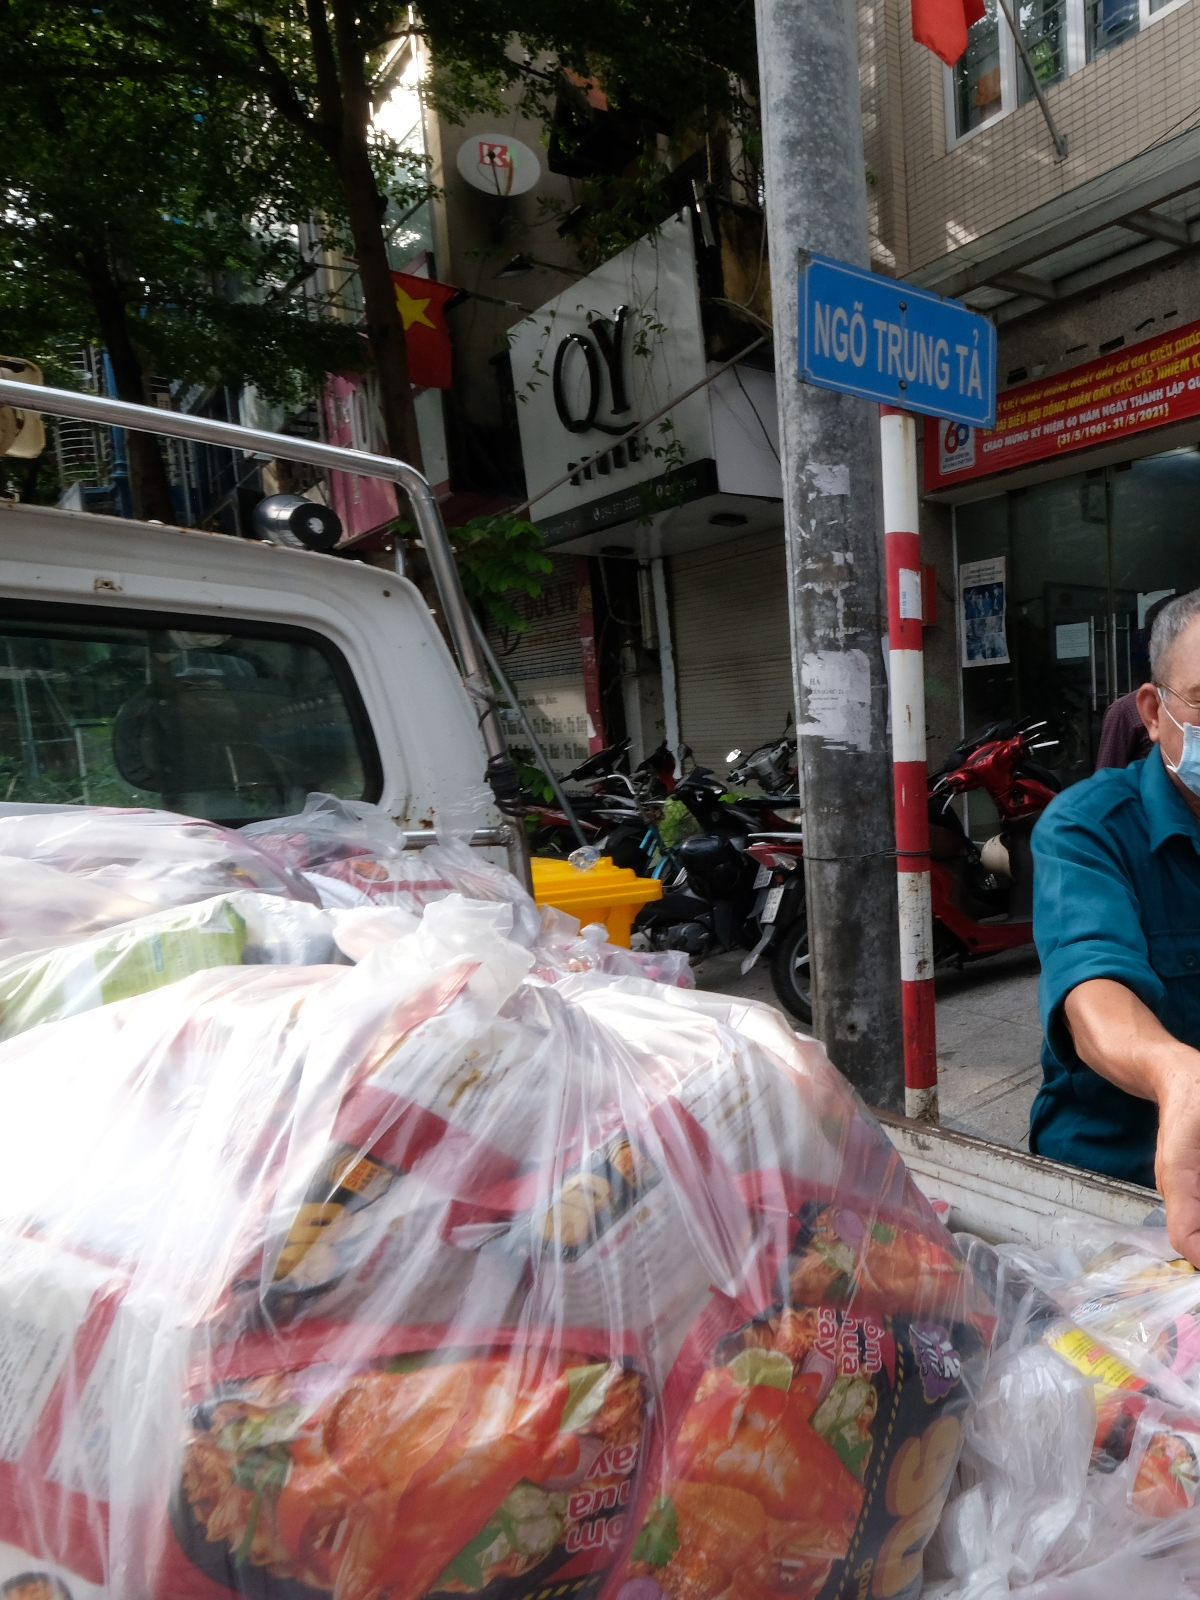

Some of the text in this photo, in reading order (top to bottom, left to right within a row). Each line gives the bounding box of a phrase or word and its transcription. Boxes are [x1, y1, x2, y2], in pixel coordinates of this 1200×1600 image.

[814, 300, 983, 400] NGÕ TRUNG TẢ
[1066, 415, 1078, 428] 60
[1102, 399, 1128, 418] NGÀY
[1129, 387, 1164, 409] THÀNH
[1165, 380, 1186, 399] LẬP
[812, 1306, 837, 1362] cay
[841, 1310, 863, 1377] hua
[862, 1320, 885, 1374] ôm
[584, 1441, 638, 1480] ay
[565, 1512, 627, 1553] ôm
